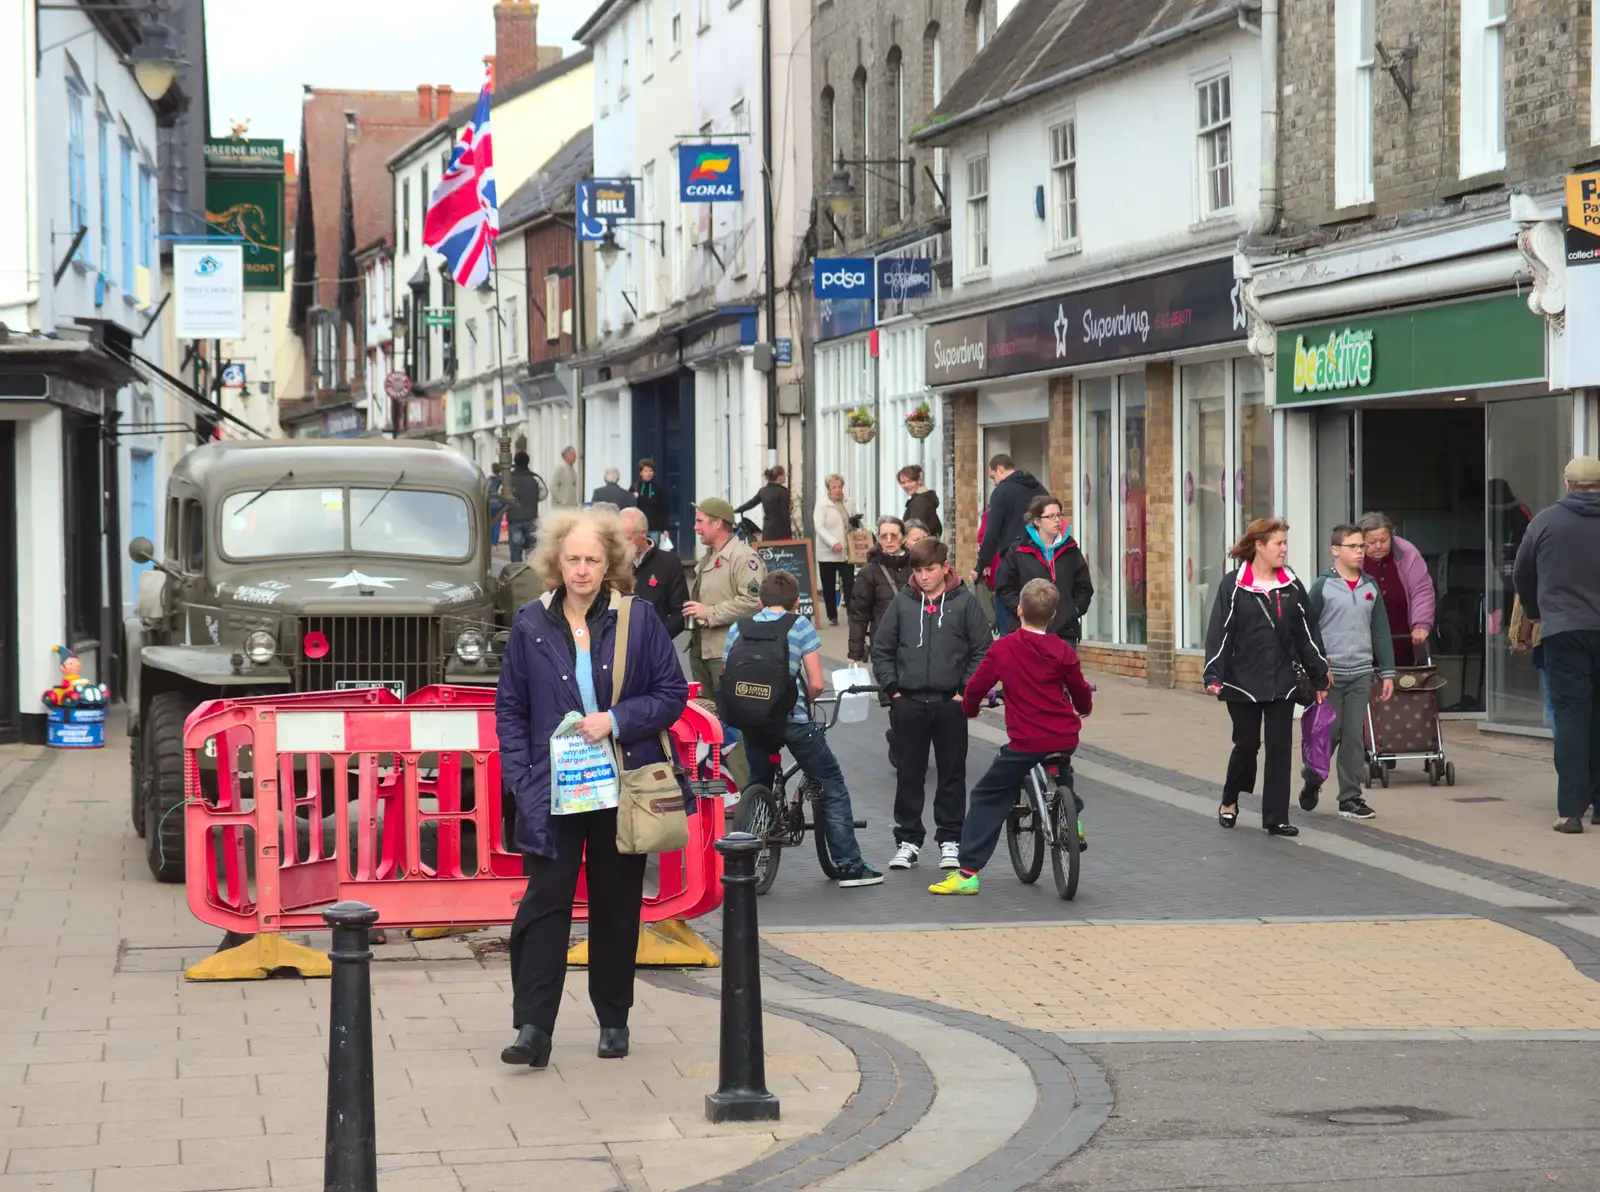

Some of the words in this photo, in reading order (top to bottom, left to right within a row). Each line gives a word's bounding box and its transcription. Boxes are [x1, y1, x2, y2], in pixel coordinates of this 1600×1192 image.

[203, 144, 247, 155] GREENE
[249, 146, 278, 156] KING
[686, 184, 734, 196] CORAL
[1581, 179, 1600, 201] P
[596, 199, 627, 214] HILL
[1583, 202, 1600, 214] Pa
[821, 267, 865, 290] pdsa
[1082, 304, 1150, 347] Superdrug
[934, 337, 985, 373] Superdrug
[1293, 327, 1372, 394] beactive
[558, 771, 582, 782] Card
